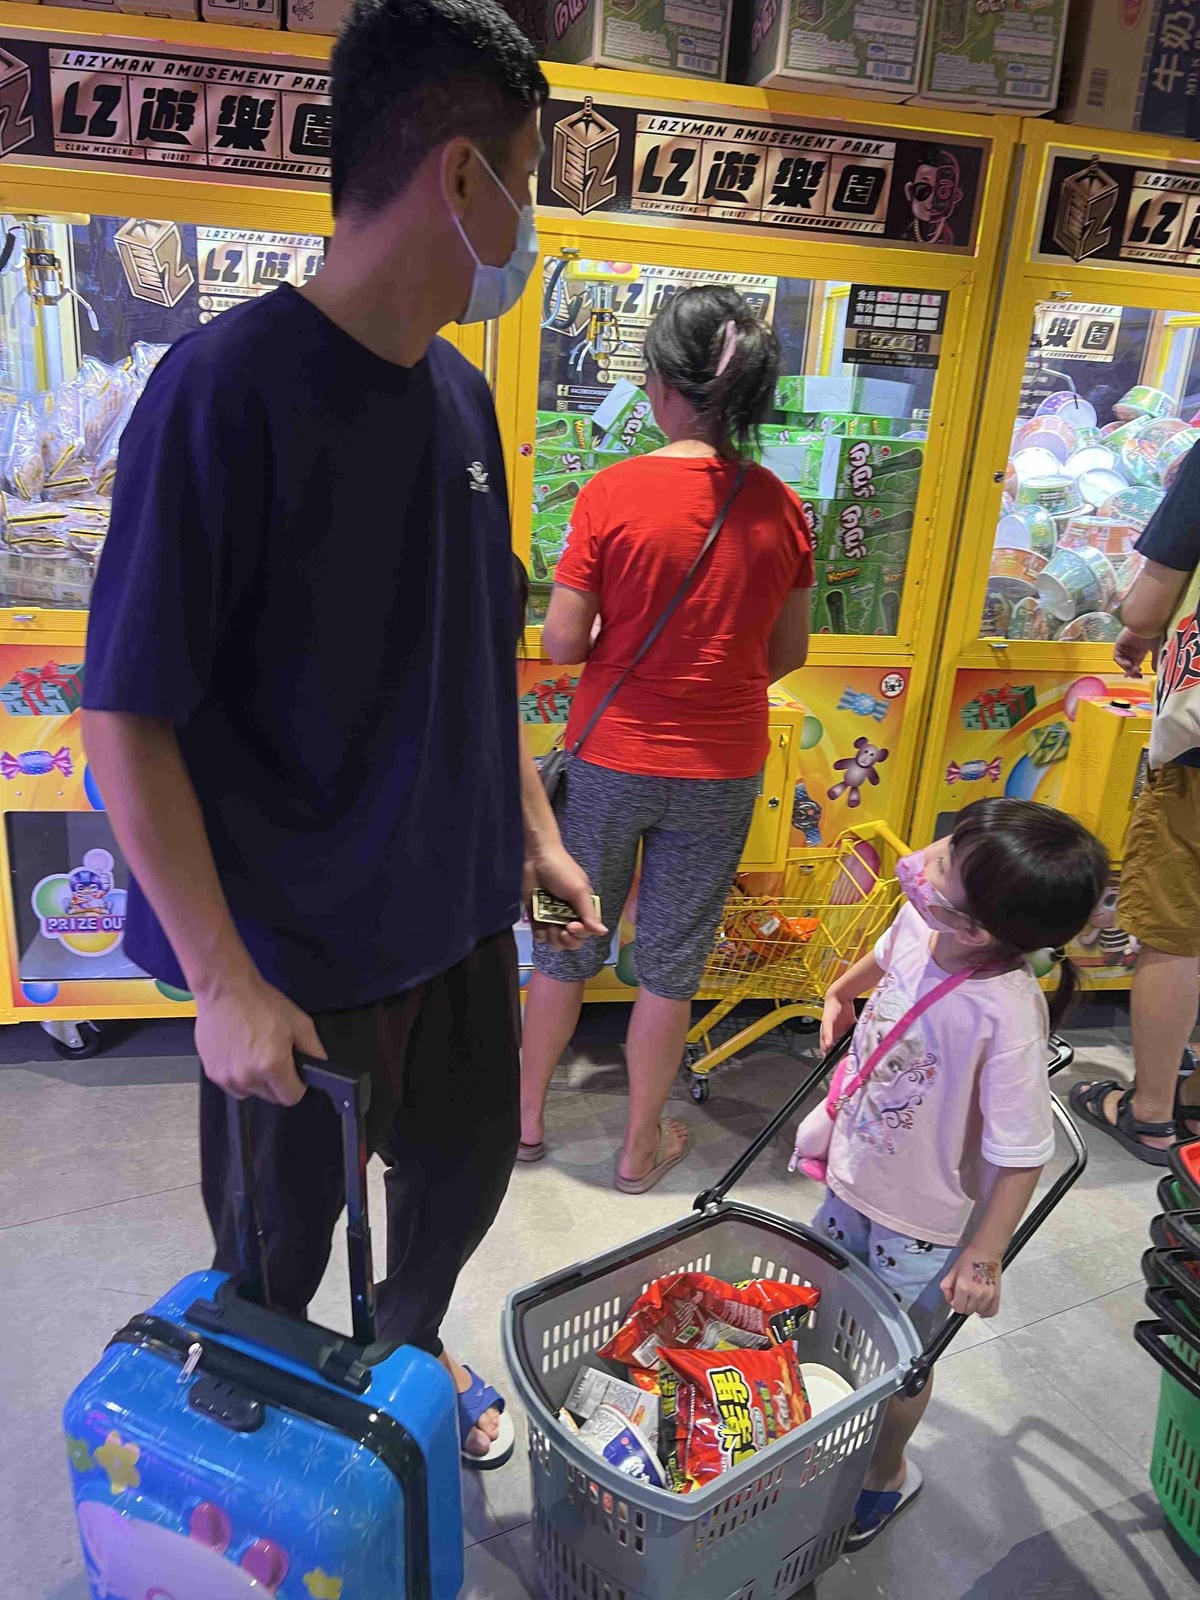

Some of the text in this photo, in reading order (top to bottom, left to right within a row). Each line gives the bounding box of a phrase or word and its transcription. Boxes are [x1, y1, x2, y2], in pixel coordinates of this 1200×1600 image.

[62, 53, 332, 92] LAZYMAN AMUSEMENT PAR
[647, 118, 886, 155] LAZYMAN AMUSEMENT PARK
[64, 142, 135, 157] CLAW MACHINE
[1142, 174, 1200, 191] LAZYMA
[205, 229, 322, 248] LAZYMAN AMUSEM
[668, 268, 738, 282] AMUSEMENT
[46, 916, 98, 931] PRIZE
[709, 1369, 757, 1468] 樂果
